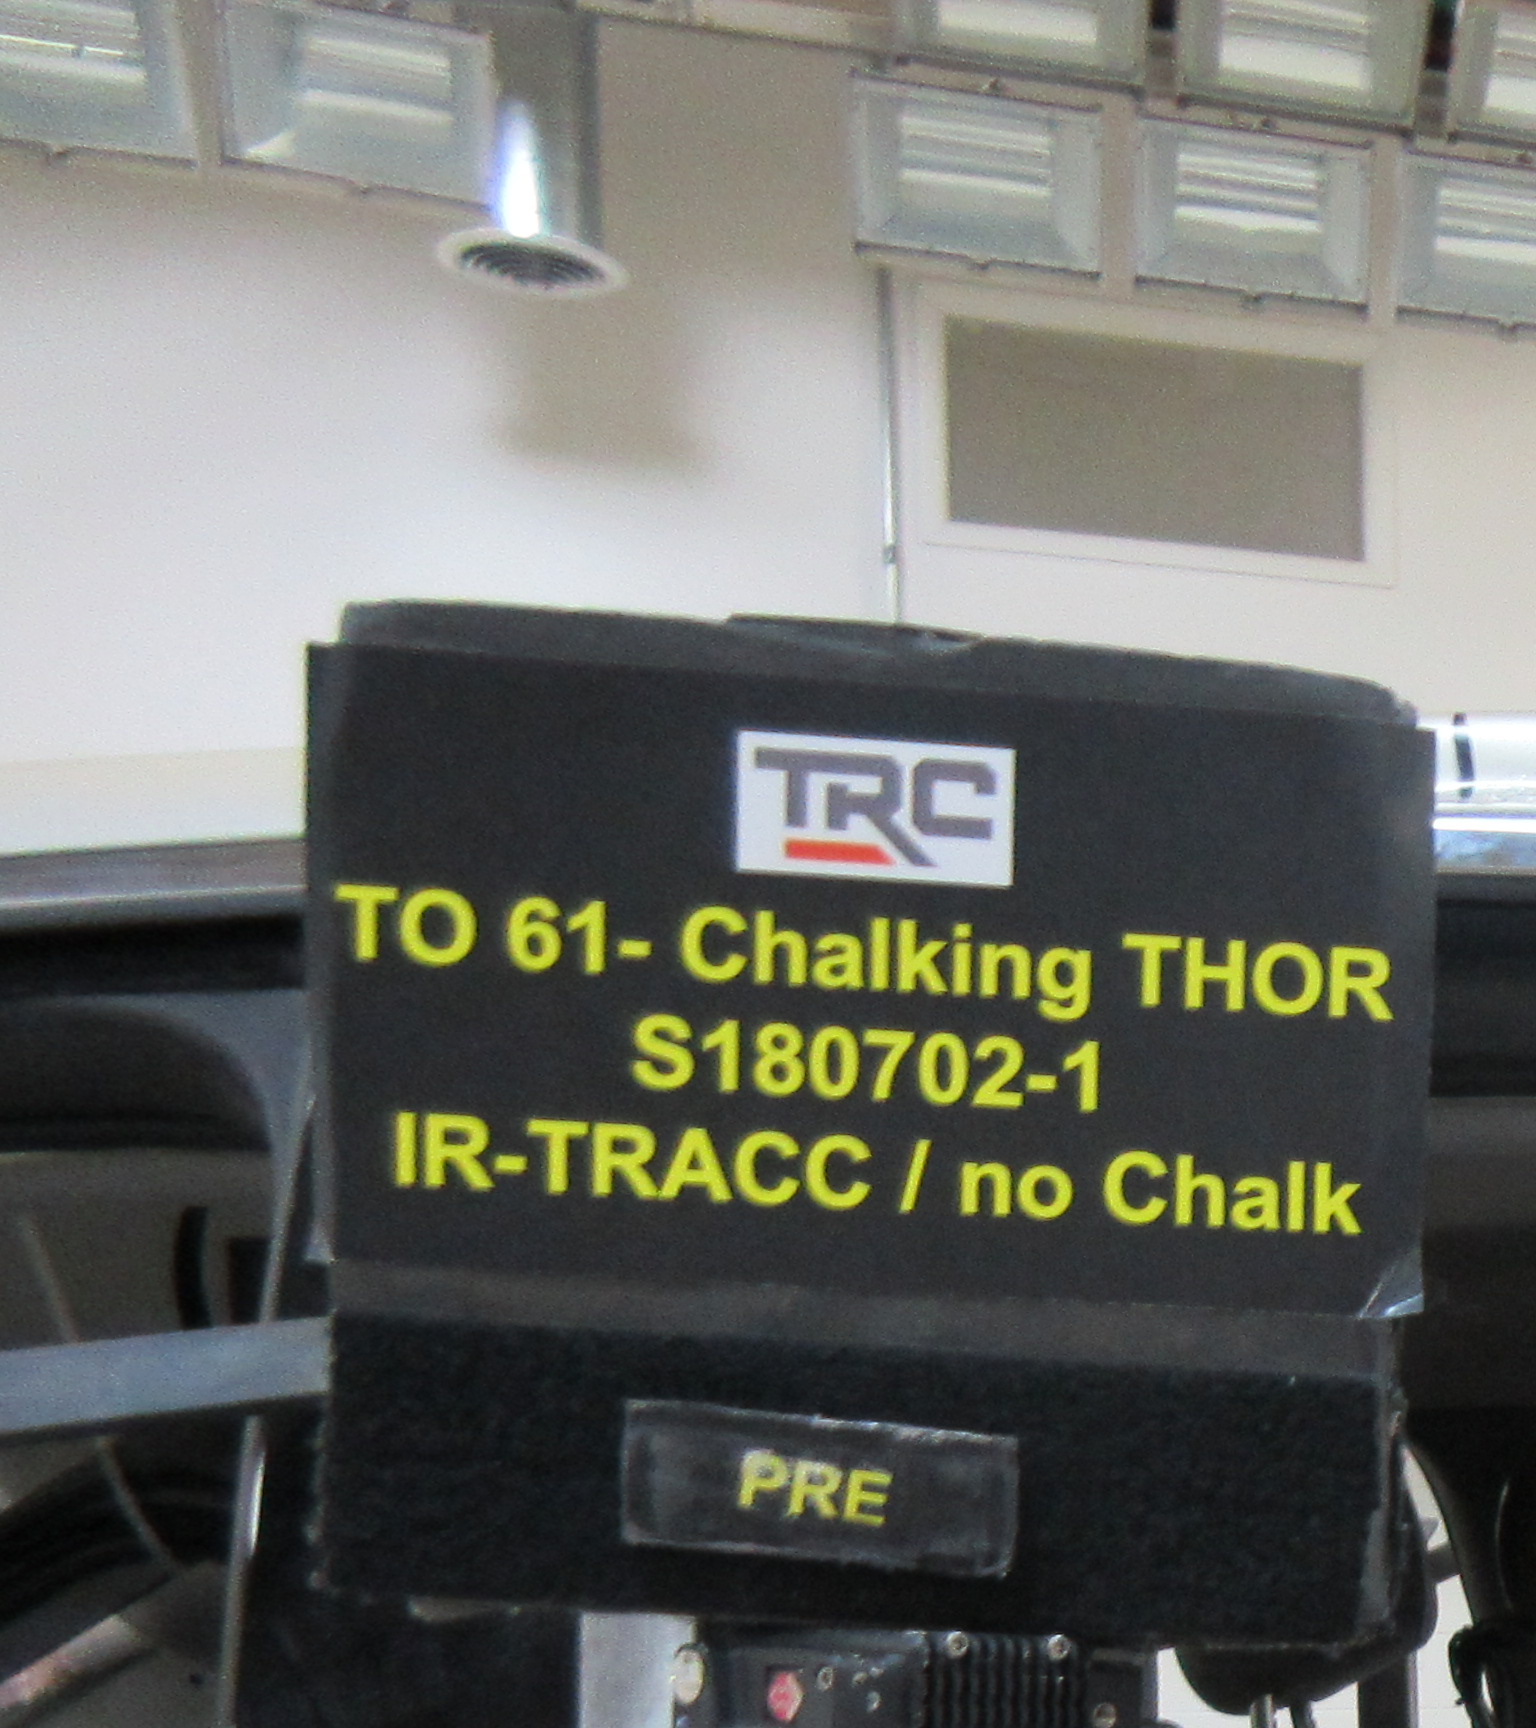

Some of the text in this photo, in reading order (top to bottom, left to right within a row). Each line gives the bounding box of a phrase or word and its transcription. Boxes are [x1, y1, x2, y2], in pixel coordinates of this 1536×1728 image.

[753, 746, 995, 866] TRC
[335, 883, 1394, 1021] TO 61- Chalking THOR
[632, 1014, 1099, 1113] S180702-1
[395, 1111, 1363, 1236] IR-TRACC / no Chalk
[736, 1447, 893, 1528] PRE
